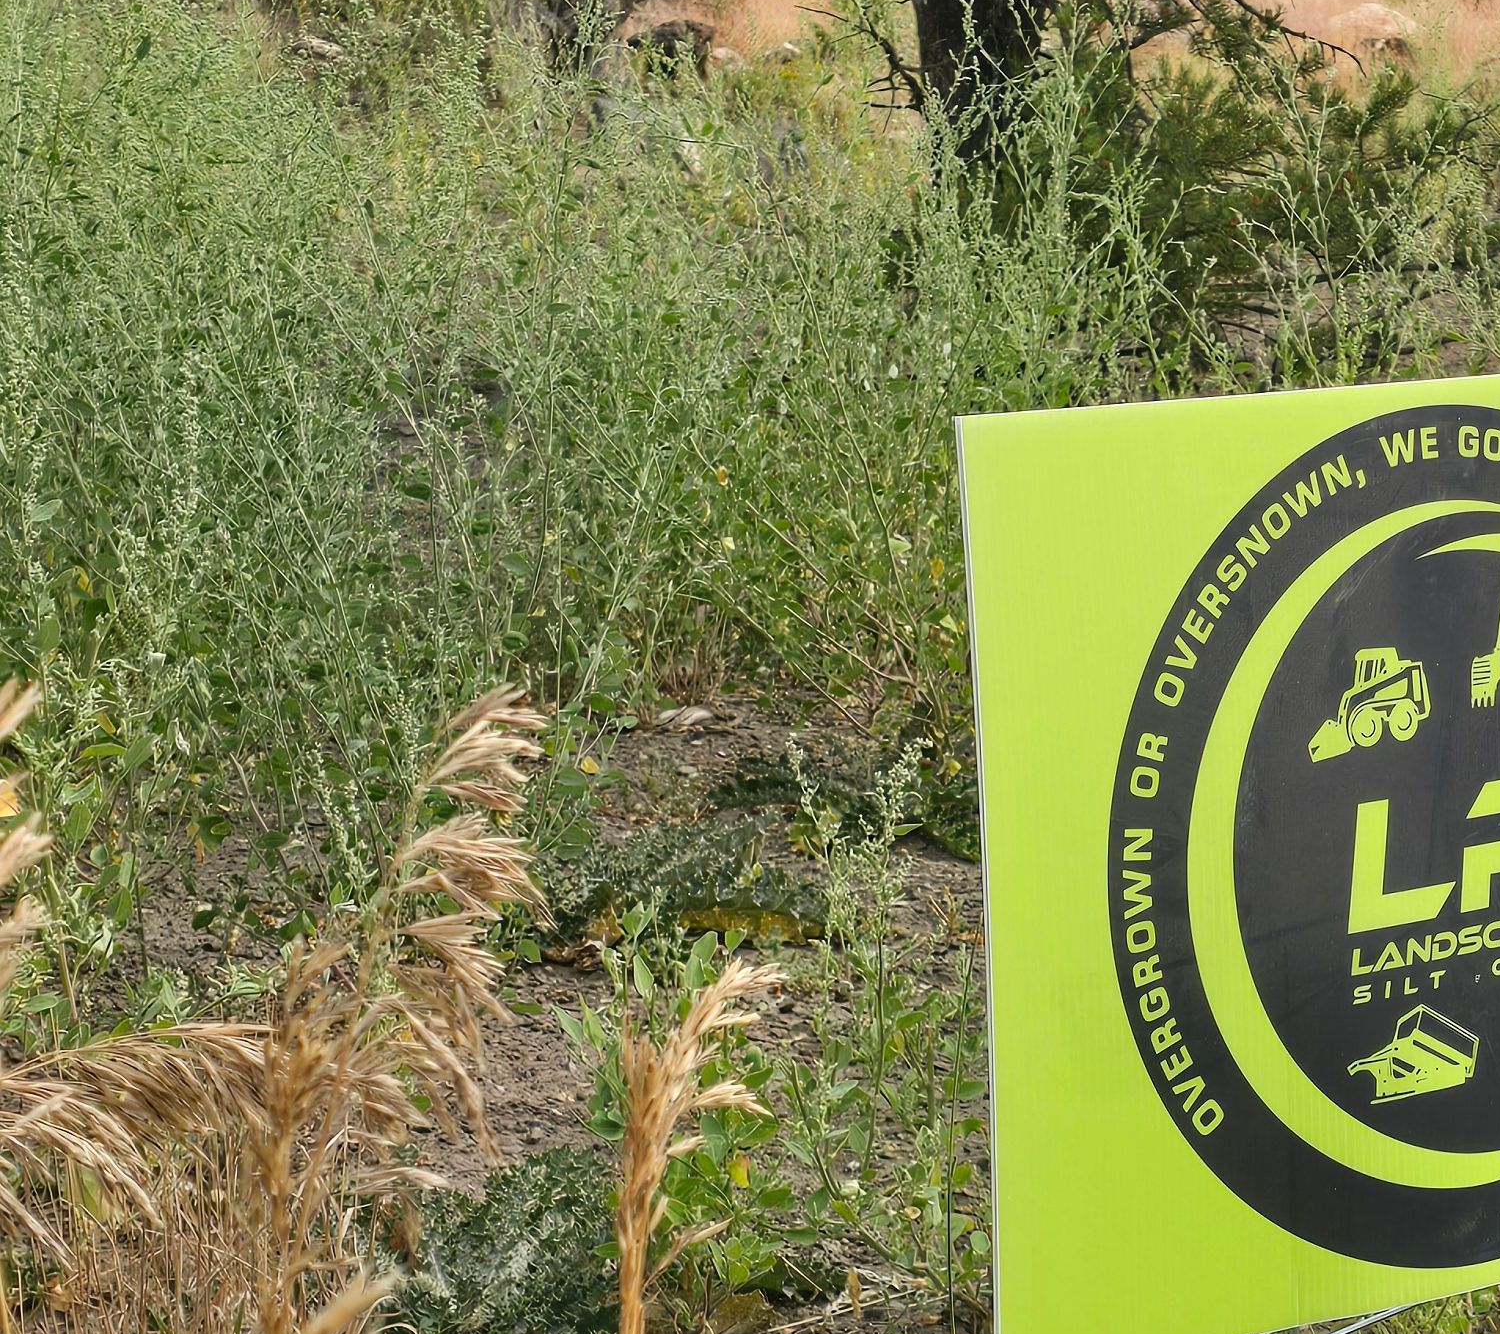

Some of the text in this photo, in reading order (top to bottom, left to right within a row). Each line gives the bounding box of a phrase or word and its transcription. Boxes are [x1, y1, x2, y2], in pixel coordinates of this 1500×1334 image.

[1378, 426, 1440, 468] WE
[1153, 453, 1367, 708] OVERSNOWN,
[1129, 731, 1169, 799] OR
[1121, 827, 1225, 1137] OVERGROWN
